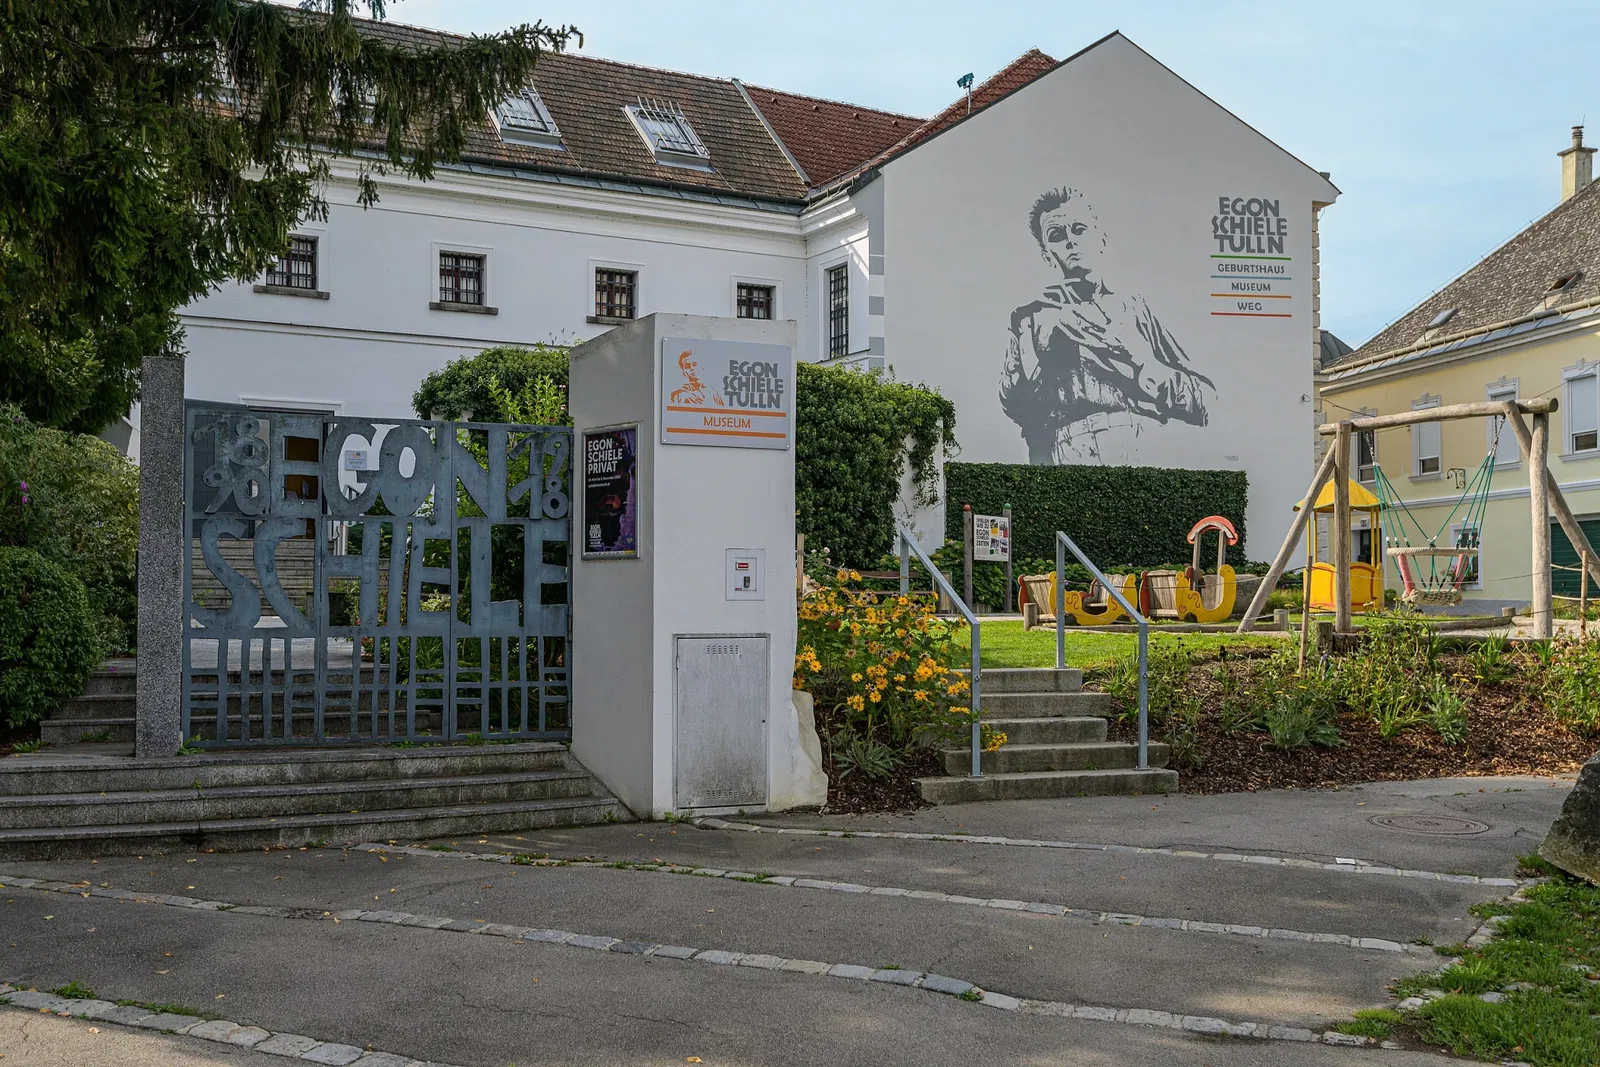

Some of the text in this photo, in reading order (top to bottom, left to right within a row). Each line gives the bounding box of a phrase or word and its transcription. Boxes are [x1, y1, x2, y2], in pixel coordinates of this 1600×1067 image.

[1219, 197, 1280, 217] EGON
[1211, 215, 1288, 236] SCHIELE
[1213, 234, 1284, 254] TULLN
[1217, 263, 1285, 274] GEBURTSHAUS
[1231, 282, 1271, 292] MUSEUM
[1237, 302, 1263, 311] WEG
[729, 360, 778, 378] EGON
[722, 375, 784, 394] SCHIELE
[724, 391, 781, 409] TULLN
[703, 416, 751, 428] MUSEUM
[587, 438, 613, 452] EGON
[587, 448, 623, 463] SCHIELE
[270, 413, 507, 518] EGON
[587, 460, 618, 475] PRIVAT
[190, 516, 569, 629] SCHIELE
